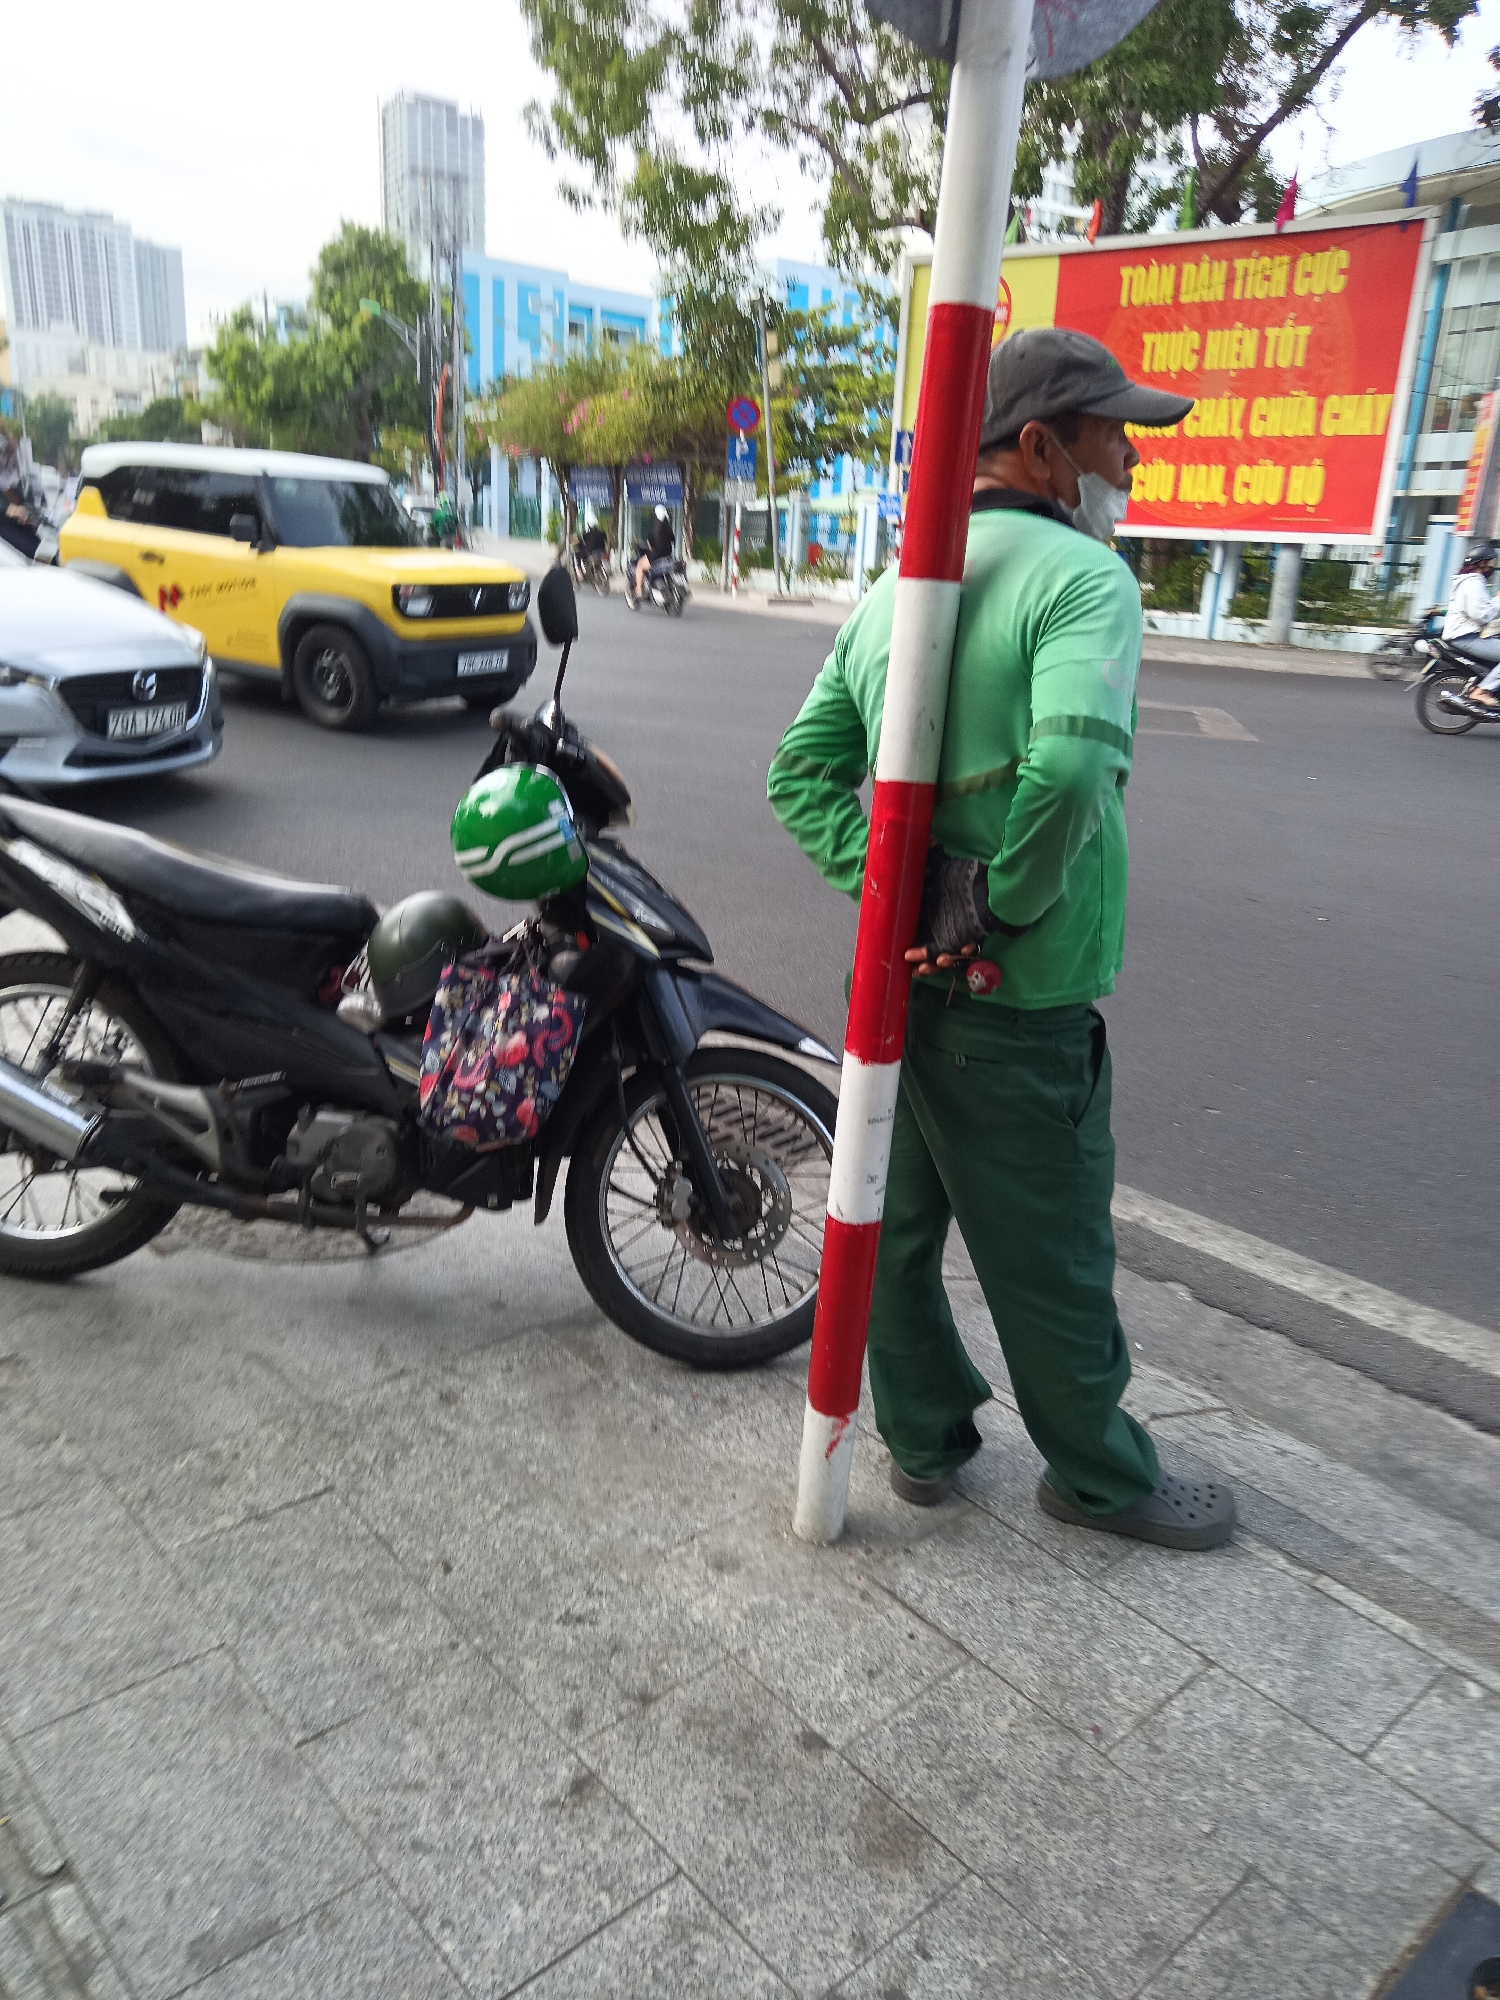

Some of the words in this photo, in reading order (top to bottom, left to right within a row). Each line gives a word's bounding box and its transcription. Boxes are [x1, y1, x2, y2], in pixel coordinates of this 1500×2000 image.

[1120, 259, 1176, 307] TOÀN
[1179, 254, 1228, 304] DÂN
[1233, 251, 1291, 299] TÍCH
[1293, 245, 1350, 302] CỰC
[1142, 326, 1201, 379] THỰC
[1204, 322, 1259, 377] HIỆN
[1264, 313, 1312, 368] TỐT
[1249, 390, 1316, 436] CHỮA
[1321, 387, 1394, 435] CHÁY
[1287, 459, 1325, 512] HỘ
